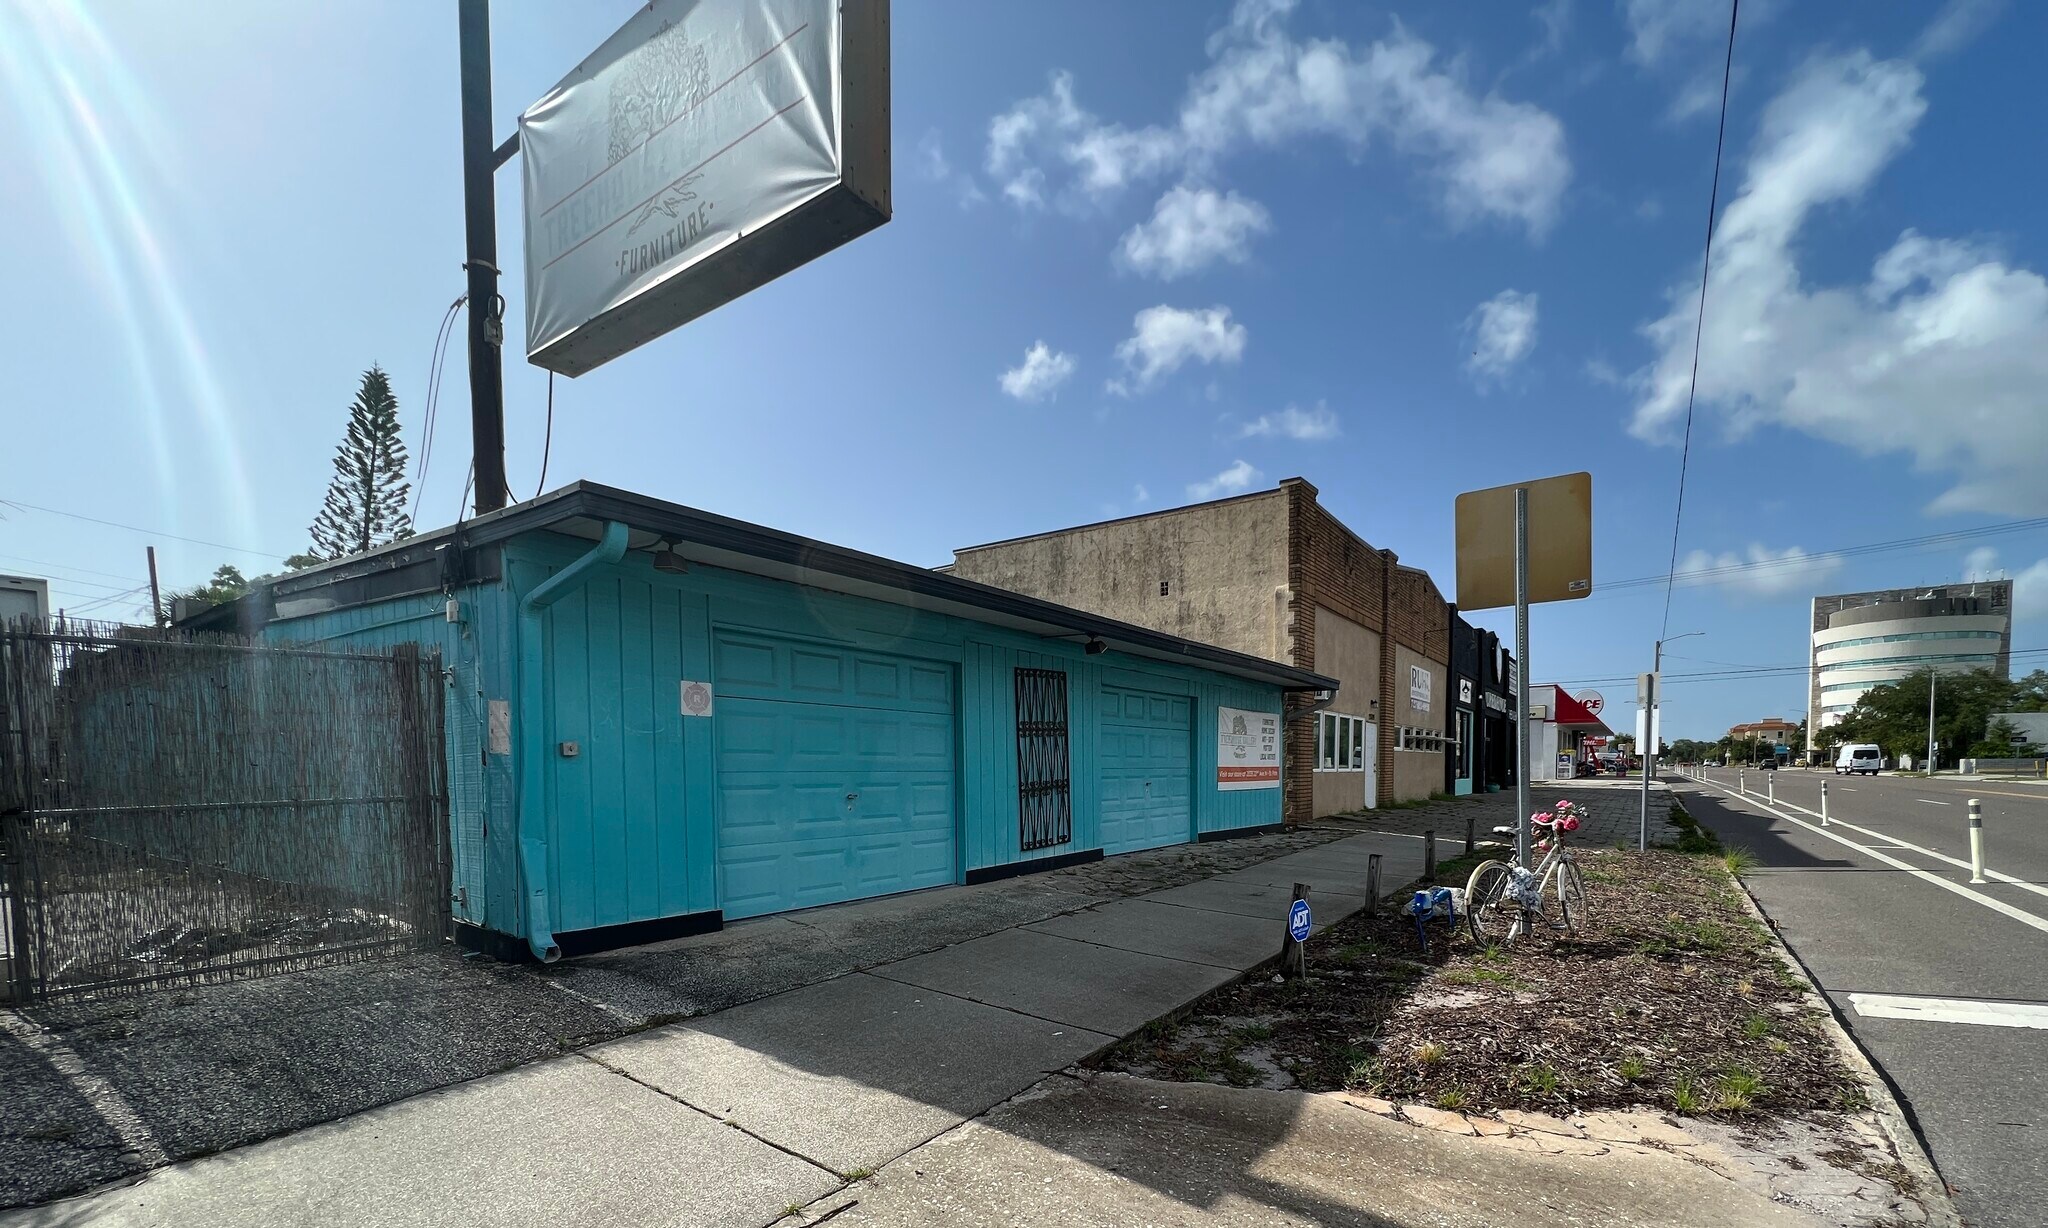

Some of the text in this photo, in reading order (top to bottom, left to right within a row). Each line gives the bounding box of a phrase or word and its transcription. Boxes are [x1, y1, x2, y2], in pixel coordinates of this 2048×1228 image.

[619, 201, 710, 276] FURNITURE
[693, 694, 702, 704] R
[1292, 909, 1309, 929] ADT
